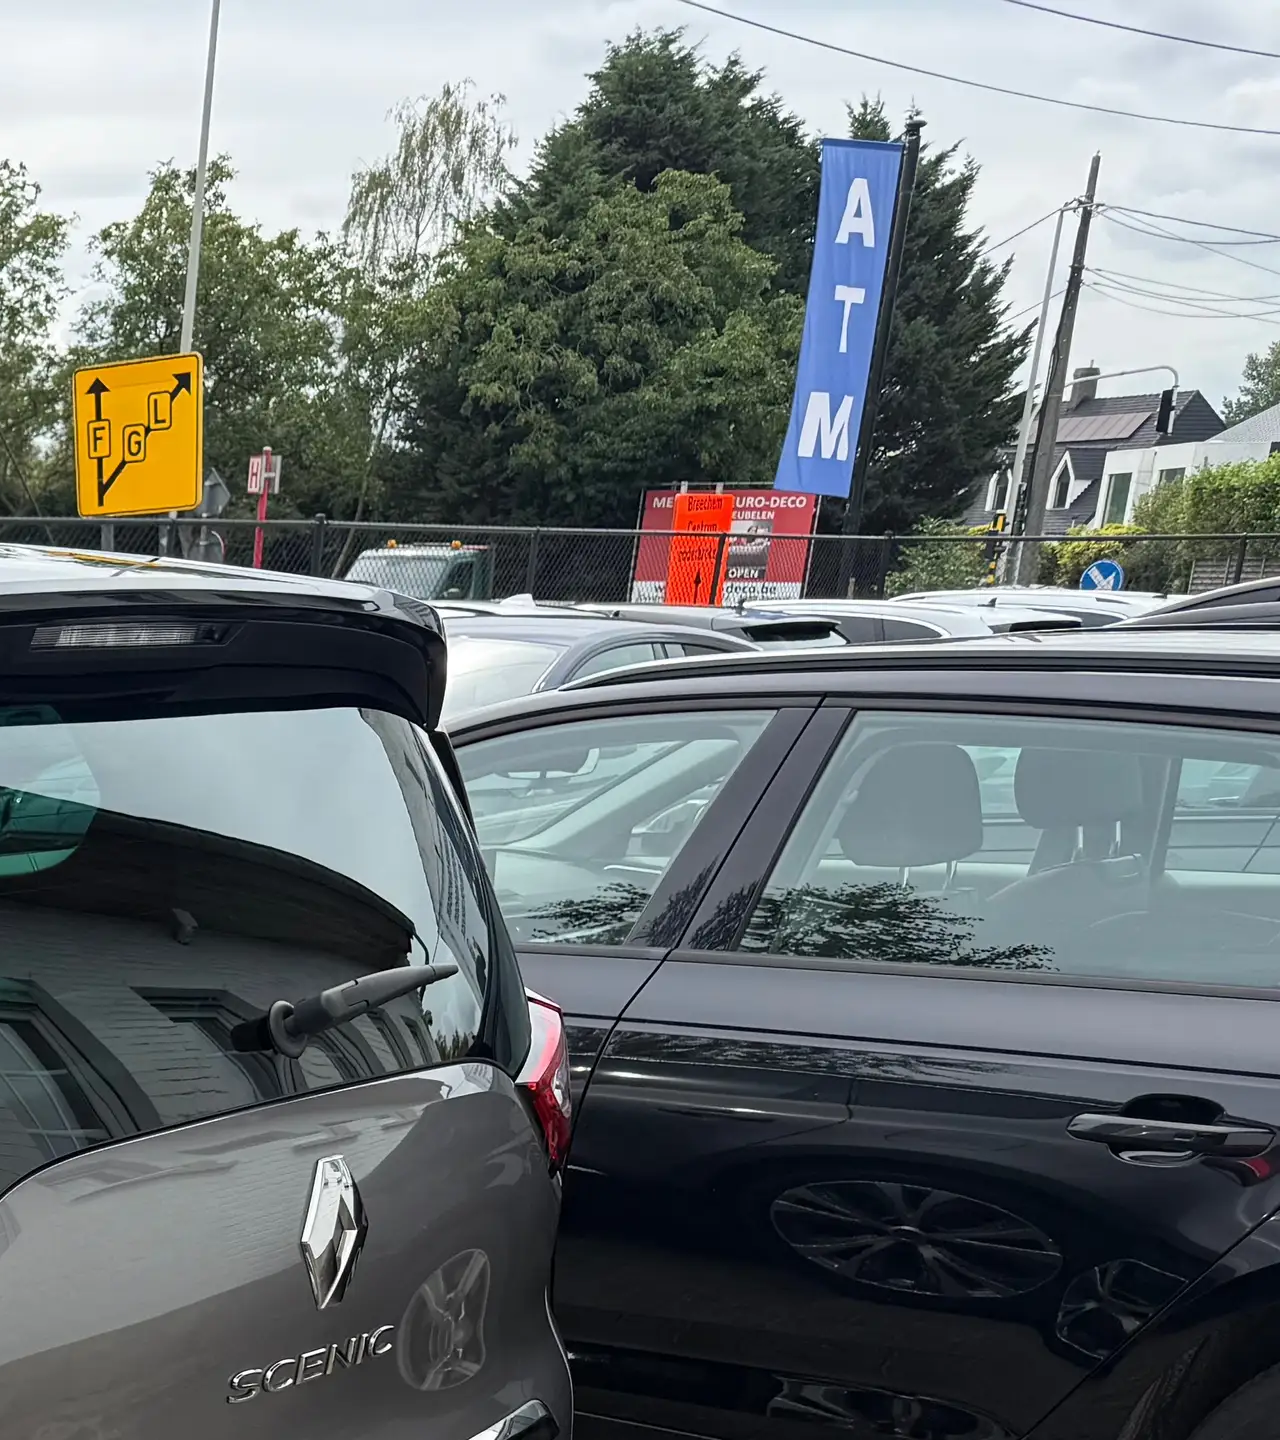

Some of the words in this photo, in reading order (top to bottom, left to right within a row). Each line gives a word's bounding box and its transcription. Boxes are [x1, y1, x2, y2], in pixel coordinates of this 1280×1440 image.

[797, 177, 875, 462] ATM
[153, 398, 167, 425] L
[92, 426, 106, 453] F
[127, 430, 142, 457] G
[731, 510, 776, 520] EUBELEN
[733, 496, 808, 509] URO-DECO
[225, 1325, 395, 1405] SCENIC
